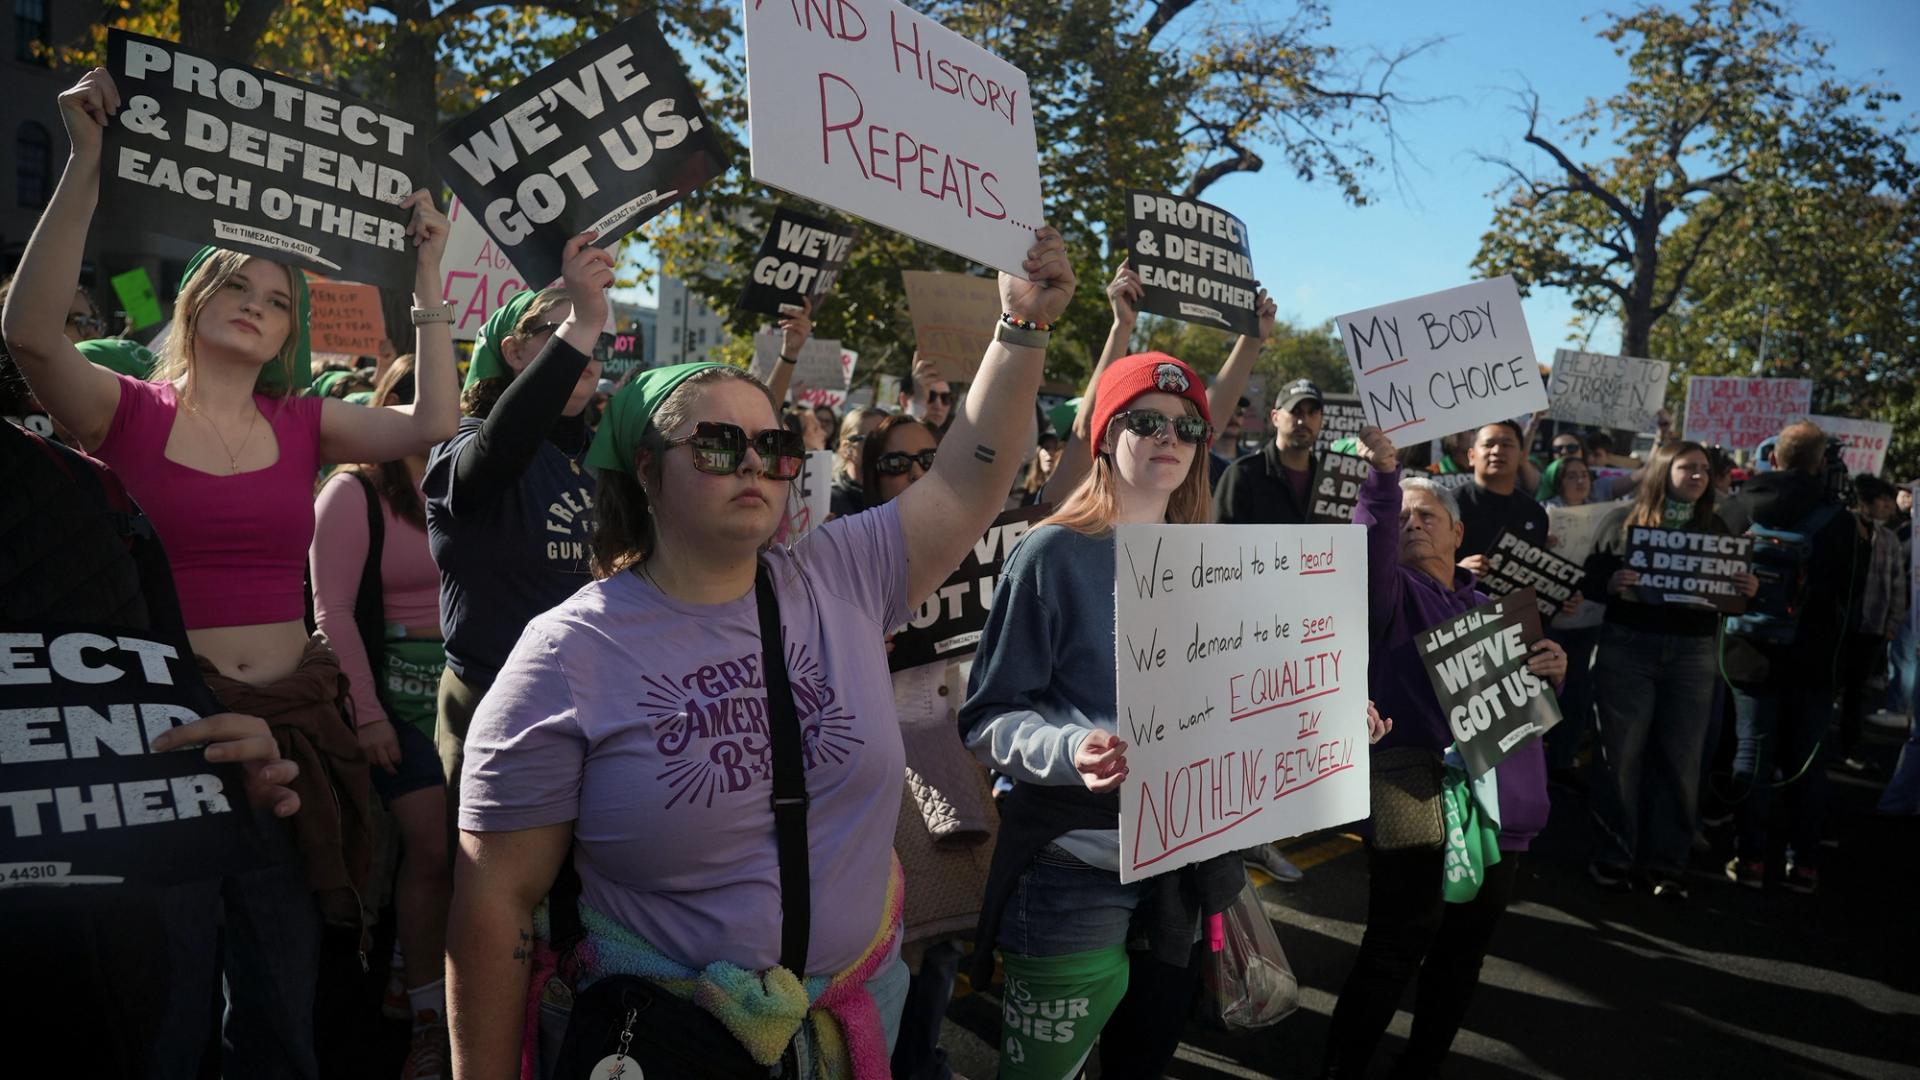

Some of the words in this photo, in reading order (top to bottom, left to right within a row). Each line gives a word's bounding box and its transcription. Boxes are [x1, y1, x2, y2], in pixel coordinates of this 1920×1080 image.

[891, 10, 1016, 125] HISTORY
[125, 40, 414, 156] PROTECT
[448, 43, 650, 187] WE'VE
[120, 95, 171, 140] &
[184, 108, 413, 205] DEFEND
[484, 145, 600, 246] GOT
[598, 98, 704, 172] US.
[117, 147, 252, 211] EACH
[261, 187, 406, 251] OTHER
[599, 207, 631, 230] TIME2ACT
[1133, 194, 1247, 248] PROTECT
[221, 223, 238, 235] Text
[239, 227, 280, 246] TIME2ACT
[281, 239, 289, 249] to
[290, 241, 313, 255] 44310
[777, 220, 853, 262] WE'VE
[1136, 229, 1160, 257] &
[1165, 234, 1255, 281] DEFEND
[753, 256, 818, 294] GOT
[1138, 264, 1195, 295] EACH
[1197, 278, 1255, 312] OTHER
[1349, 316, 1403, 370] MY
[1418, 301, 1497, 350] BODY
[1369, 382, 1416, 430] MY
[1428, 356, 1529, 410] CHOICE
[1638, 360, 1664, 383] TO
[546, 487, 594, 535] FREE
[546, 541, 583, 560] GUN
[1125, 536, 1174, 599] We
[1191, 542, 1243, 589] demand
[1251, 545, 1265, 574] to
[1275, 541, 1290, 570] be
[1299, 536, 1334, 570] heard
[1498, 532, 1586, 585] PROTECT
[1629, 550, 1648, 568] &
[1652, 552, 1748, 577] DEFEND
[1632, 528, 1750, 556] PROTECT
[1501, 560, 1571, 601] DEFEND
[1682, 577, 1738, 596] OTHE
[0, 632, 179, 686] ECT
[1127, 628, 1167, 673] We
[1186, 620, 1244, 663] demand
[1253, 621, 1268, 643] to
[1275, 614, 1290, 638] be
[1302, 615, 1334, 638] seen
[1434, 622, 1528, 695] WE'VE
[682, 651, 768, 698] GRE
[1128, 705, 1165, 747] We
[1179, 696, 1215, 731] want
[1230, 650, 1342, 715] EQUALITY
[1298, 710, 1322, 735] IN
[1450, 683, 1506, 742] GOT
[1501, 664, 1548, 707] US.
[0, 773, 232, 838] THER
[1134, 748, 1267, 865] NOTHING
[9, 865, 57, 881] 44310
